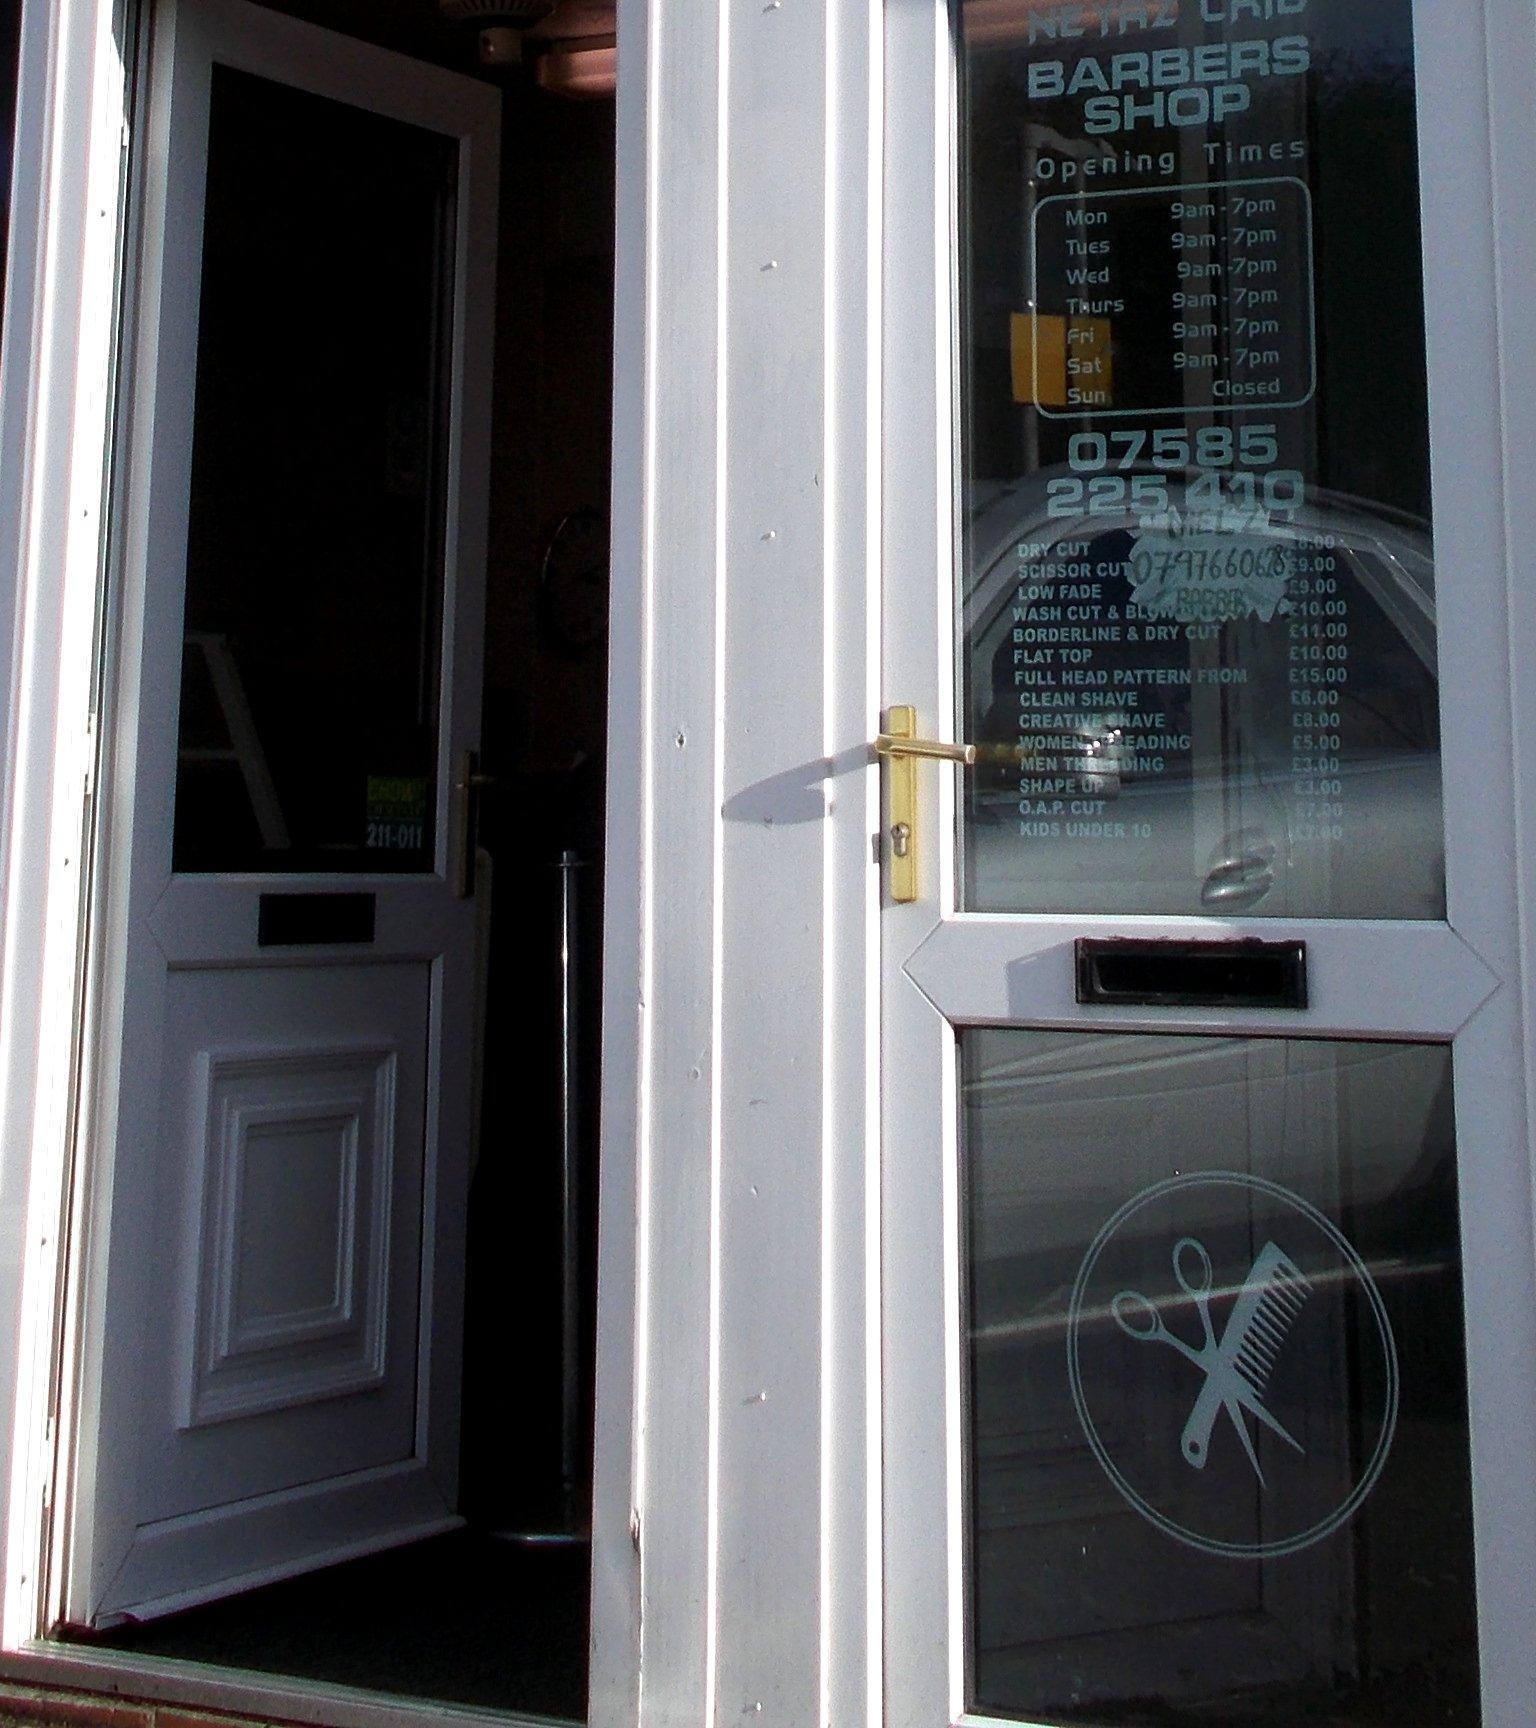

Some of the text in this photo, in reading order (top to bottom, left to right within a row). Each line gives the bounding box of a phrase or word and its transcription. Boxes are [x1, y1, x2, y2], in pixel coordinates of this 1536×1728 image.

[1028, 36, 1311, 98] BARBERS
[1084, 83, 1252, 134] SHOP
[1035, 139, 1305, 184] Opening Times
[1065, 208, 1107, 226] Mon
[1171, 202, 1215, 219] 9am
[1232, 198, 1276, 216] 7pm
[1066, 238, 1110, 256] Tues
[1171, 232, 1215, 249] 9am
[1233, 228, 1276, 247] 7pm
[1066, 267, 1109, 285] Wed
[1177, 261, 1221, 278] 9am
[1067, 297, 1125, 315] Thurs
[1172, 292, 1217, 309] 9am
[1234, 288, 1278, 307] 7pm
[1068, 327, 1094, 345] Fri
[1172, 322, 1217, 339] 9am
[1234, 318, 1279, 338] 7pm
[1068, 356, 1102, 374] Sat
[1173, 352, 1218, 369] 9am
[1235, 348, 1279, 367] 7pm
[1068, 378, 1280, 404] Sun Closed
[1069, 425, 1278, 471] 07585
[1047, 469, 1305, 517] 225 410
[1018, 544, 1047, 557] DRY
[1056, 542, 1089, 556] CUT
[1019, 563, 1091, 578] SCISSOR
[1097, 562, 1131, 575] CUT
[1019, 579, 1336, 600] LOW FADE £9.00
[1013, 606, 1061, 621] WASH
[1067, 606, 1102, 620] CUT
[1108, 605, 1118, 619] &
[1291, 601, 1347, 616] £10.00
[1014, 623, 1347, 642] BORDERLINE & DRY CUT £11.00
[1014, 645, 1347, 664] FLAT TOP £10.00
[1015, 668, 1347, 685] FULL HEAD PATTERN FROM £15.00
[1020, 692, 1076, 707] CLEAN
[1082, 691, 1138, 706] SHAVE
[1018, 714, 1102, 728] CREATIVE
[1021, 757, 1057, 771] MEN
[1019, 779, 1076, 793] SHAPE
[1071, 800, 1106, 814] CUT
[1020, 822, 1060, 837] KIDS
[1066, 823, 1125, 837] UNDER
[1134, 824, 1152, 837] 10
